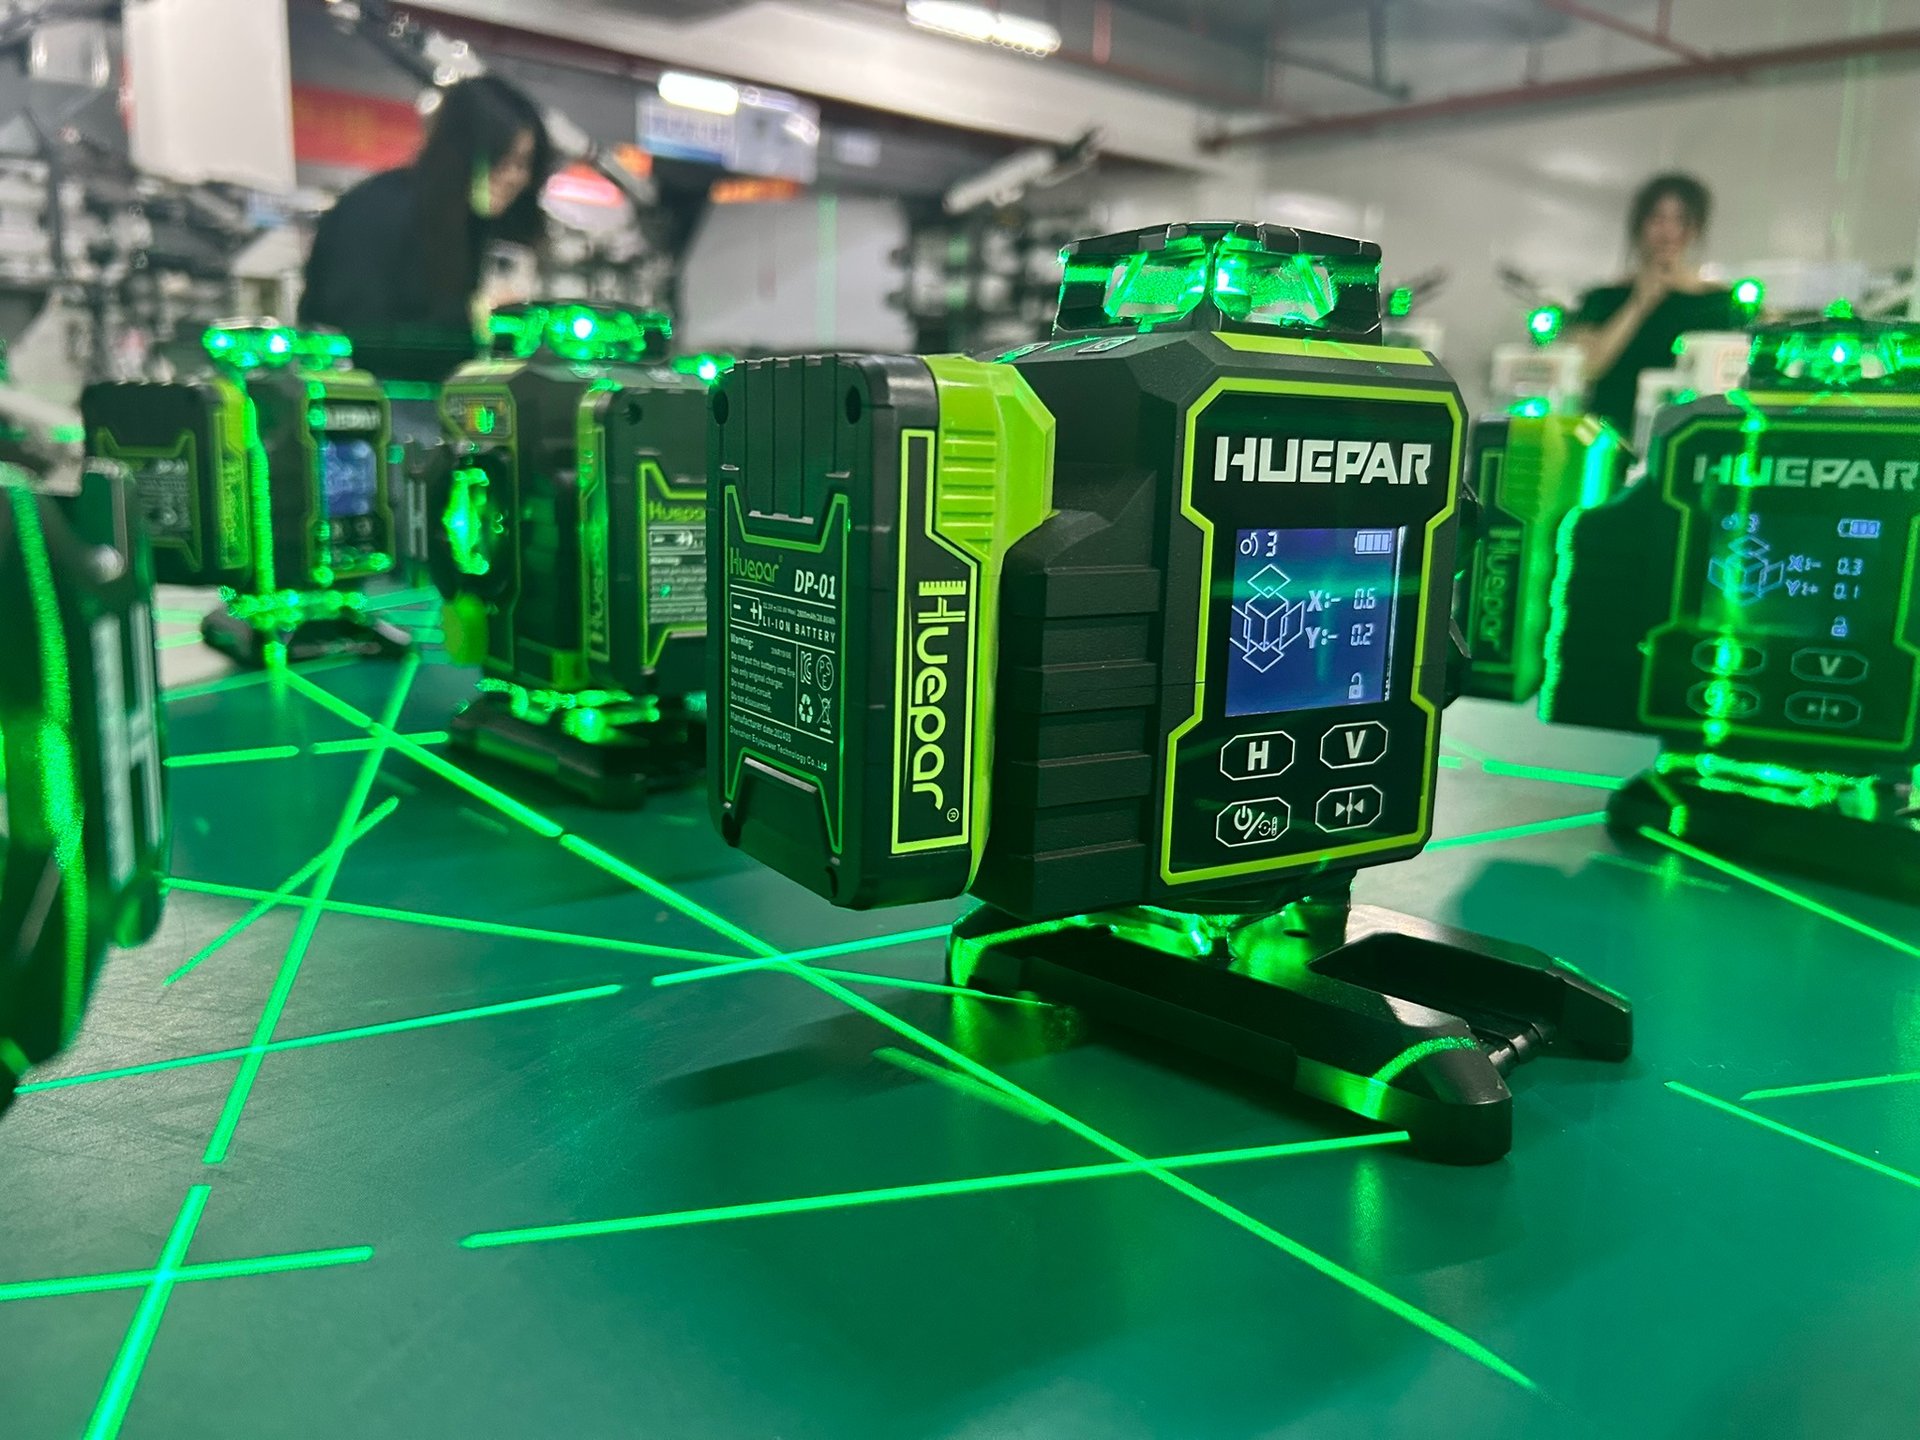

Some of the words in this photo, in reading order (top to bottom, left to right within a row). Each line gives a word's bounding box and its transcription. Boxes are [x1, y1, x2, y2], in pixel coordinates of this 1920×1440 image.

[1214, 436, 1432, 485] HUEPAR
[1693, 454, 1920, 490] HUEPAR
[1265, 531, 1278, 557] 3
[730, 547, 779, 582] Huepar
[794, 569, 836, 600] DP-01
[1353, 588, 1376, 610] 0.6
[762, 616, 791, 632] LI-ION
[795, 623, 836, 644] BATTERY
[1350, 623, 1374, 646] 0.2
[1819, 655, 1842, 676] V
[910, 580, 967, 811] Huepar
[1247, 740, 1270, 771] H
[1345, 729, 1367, 759] V
